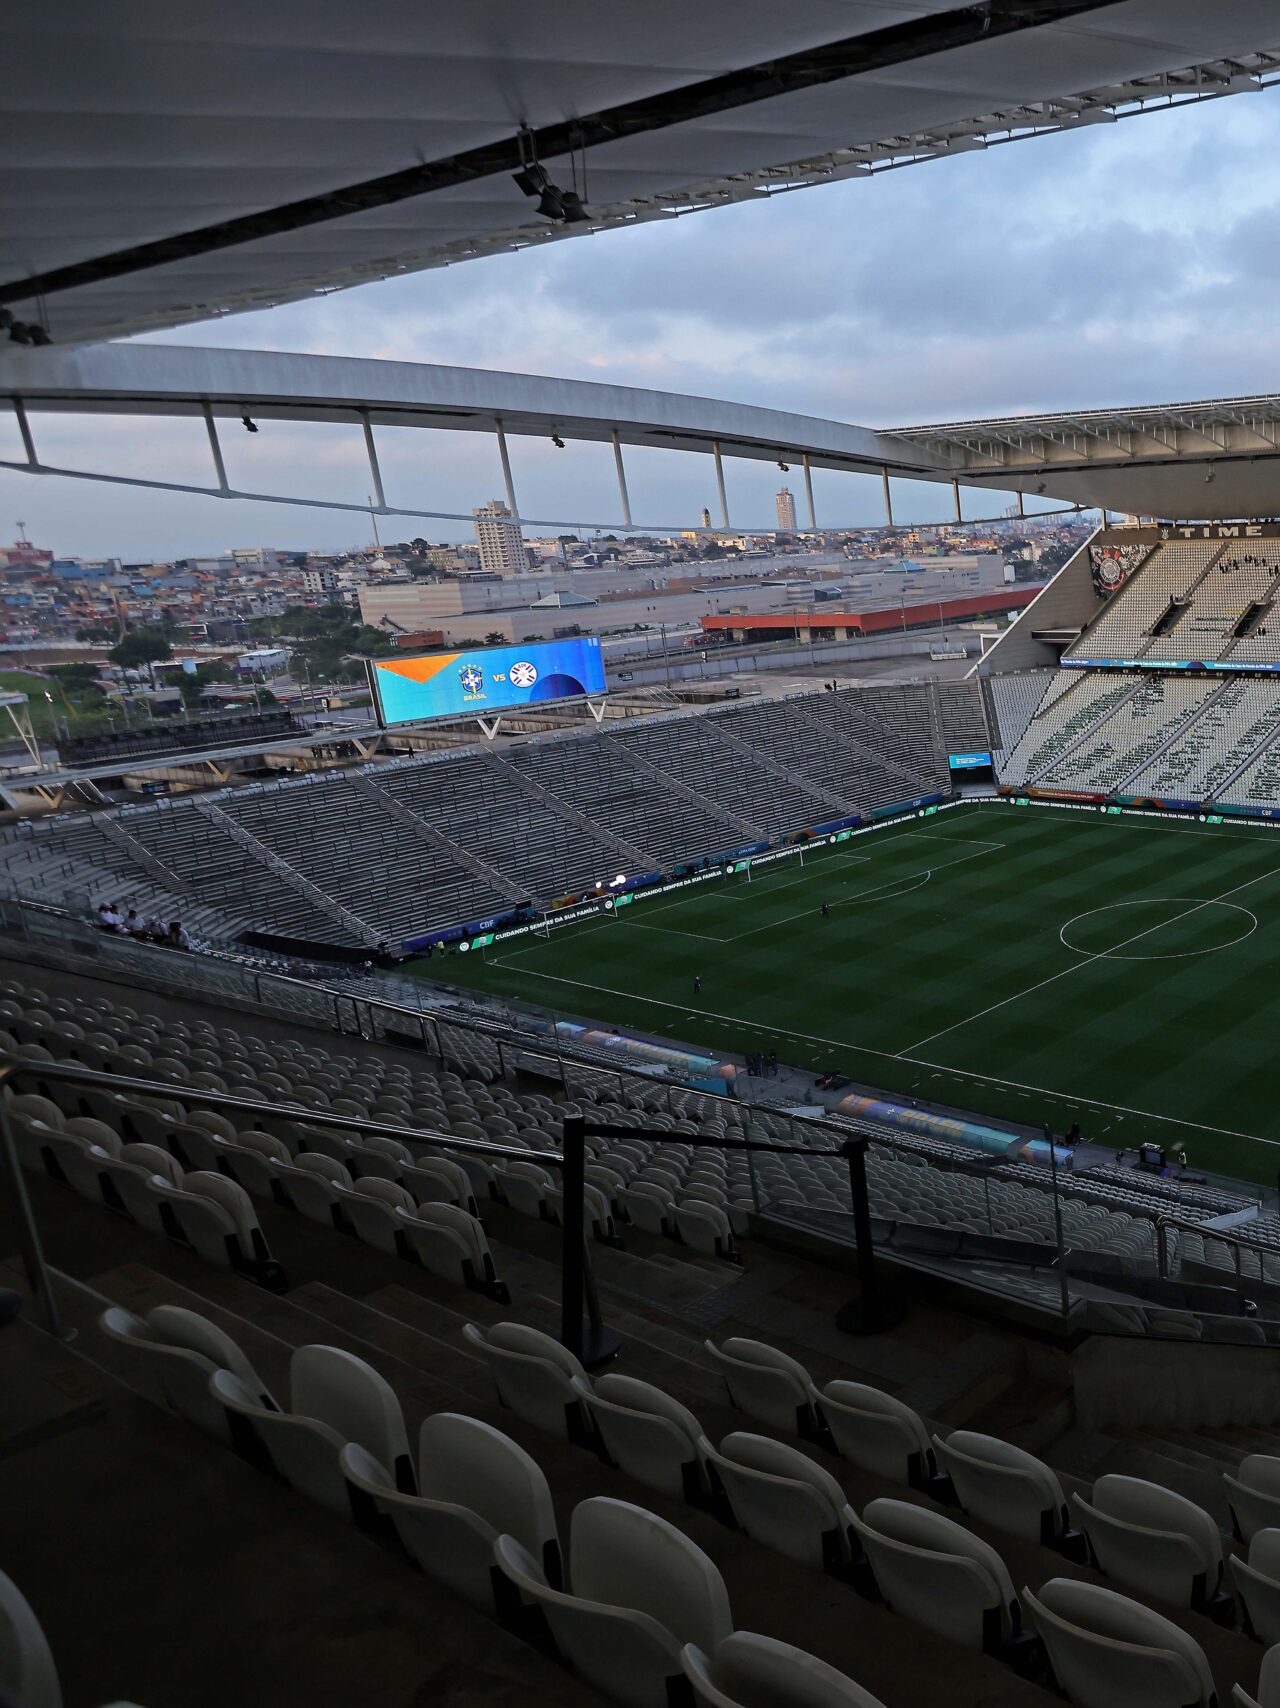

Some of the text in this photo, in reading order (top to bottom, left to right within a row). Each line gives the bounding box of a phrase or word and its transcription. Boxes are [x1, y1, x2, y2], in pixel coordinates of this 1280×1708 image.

[1179, 525, 1262, 538] TIME
[493, 673, 506, 682] VS
[463, 693, 487, 702] BRASIL
[634, 887, 662, 900] CUIDANDO
[663, 882, 683, 892] SEMPRE
[702, 870, 722, 880] FAMÍLIA
[480, 919, 494, 930] CBF
[495, 926, 529, 940] CUIDANDO
[529, 919, 553, 931] SEMPRE
[564, 912, 576, 920] SUA
[577, 906, 600, 917] FAMÍLIA
